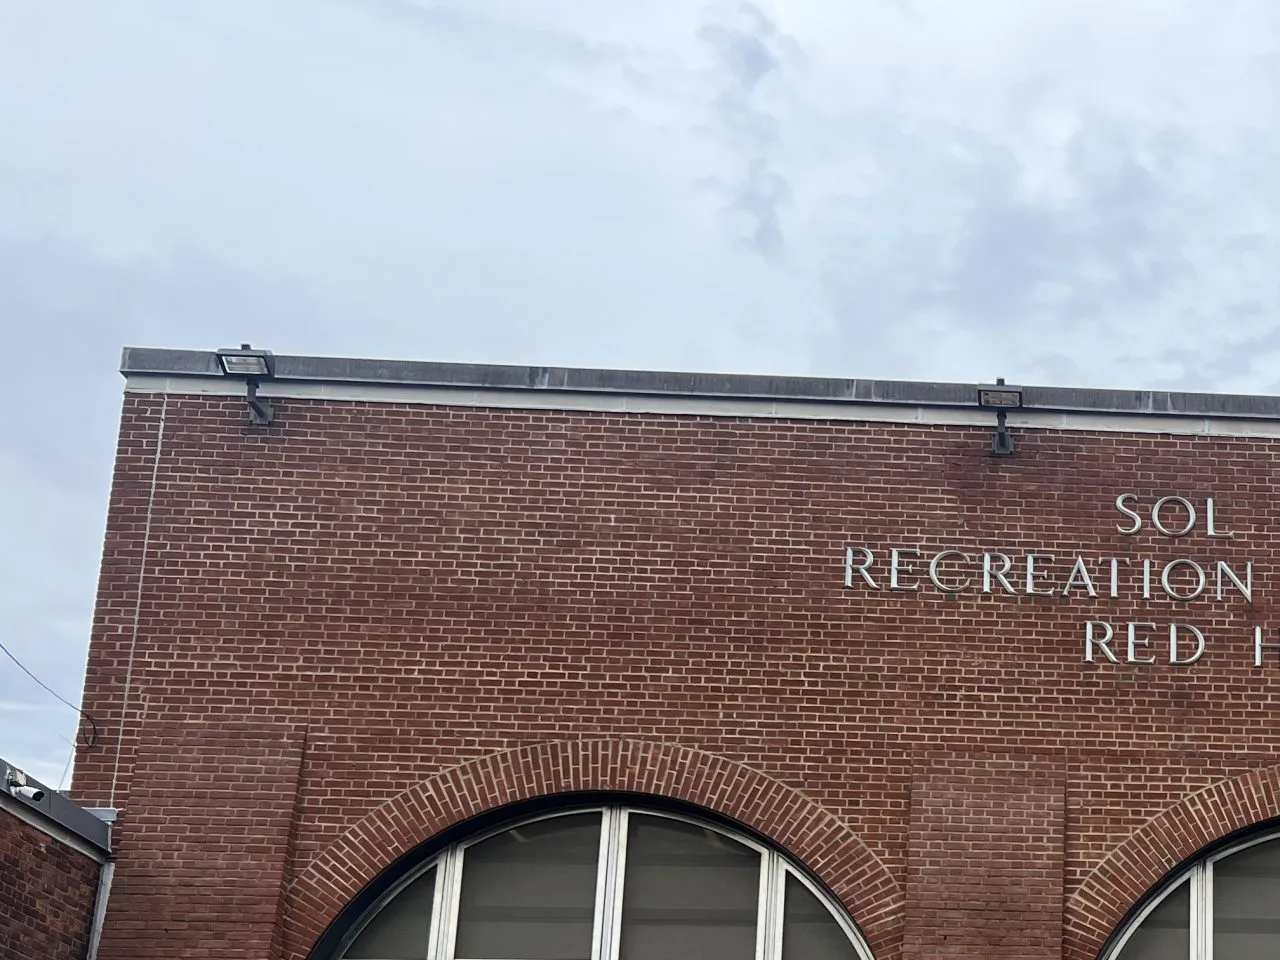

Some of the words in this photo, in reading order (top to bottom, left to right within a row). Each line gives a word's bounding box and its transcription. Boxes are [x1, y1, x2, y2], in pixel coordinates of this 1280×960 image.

[1115, 493, 1235, 539] SOL
[843, 546, 1254, 604] RECREATION
[1083, 620, 1206, 666] RED
